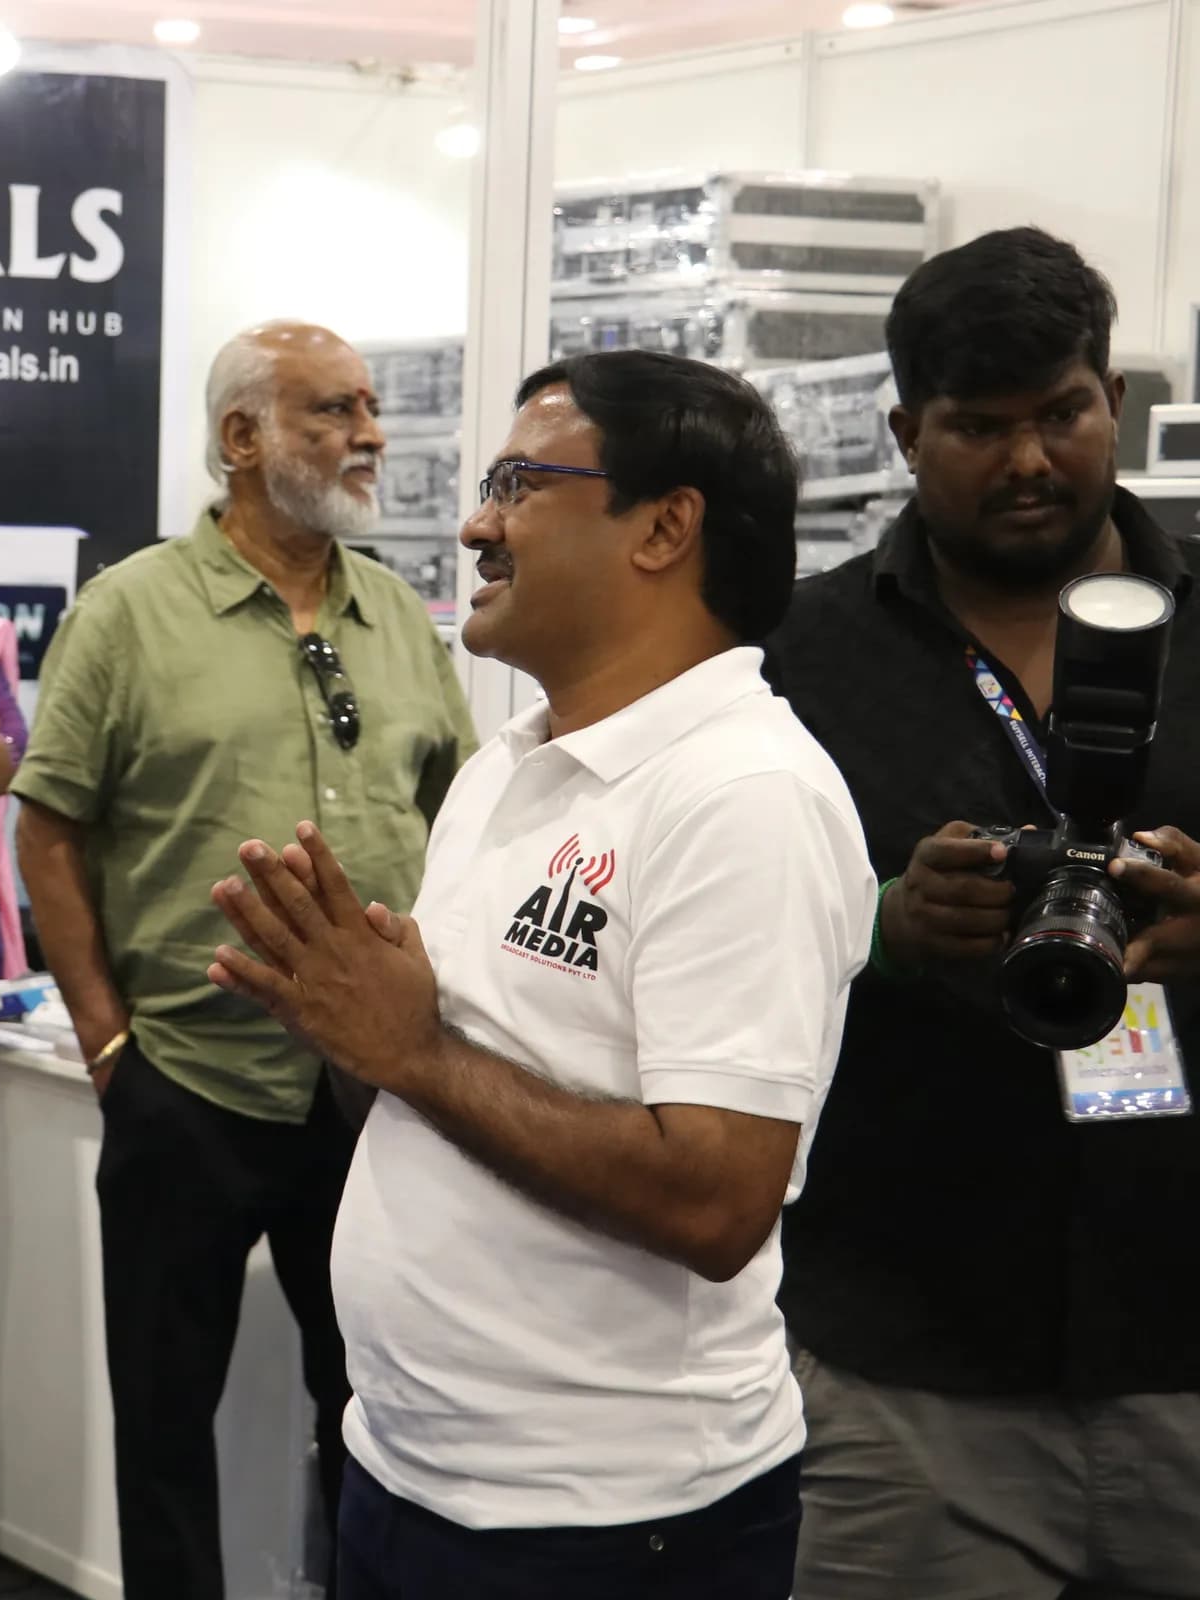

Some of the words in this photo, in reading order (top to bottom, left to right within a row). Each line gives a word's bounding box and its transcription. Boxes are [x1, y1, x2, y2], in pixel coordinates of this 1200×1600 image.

[48, 309, 123, 337] HUB
[1009, 719, 1029, 749] BUYSELL
[1065, 848, 1105, 862] Canon
[513, 857, 608, 947] AIR
[501, 943, 529, 960] BROADCAST
[530, 953, 567, 973] SOLUTIONS
[568, 964, 582, 978] PVT
[583, 971, 597, 982] LTD
[504, 920, 598, 972] MEDIA
